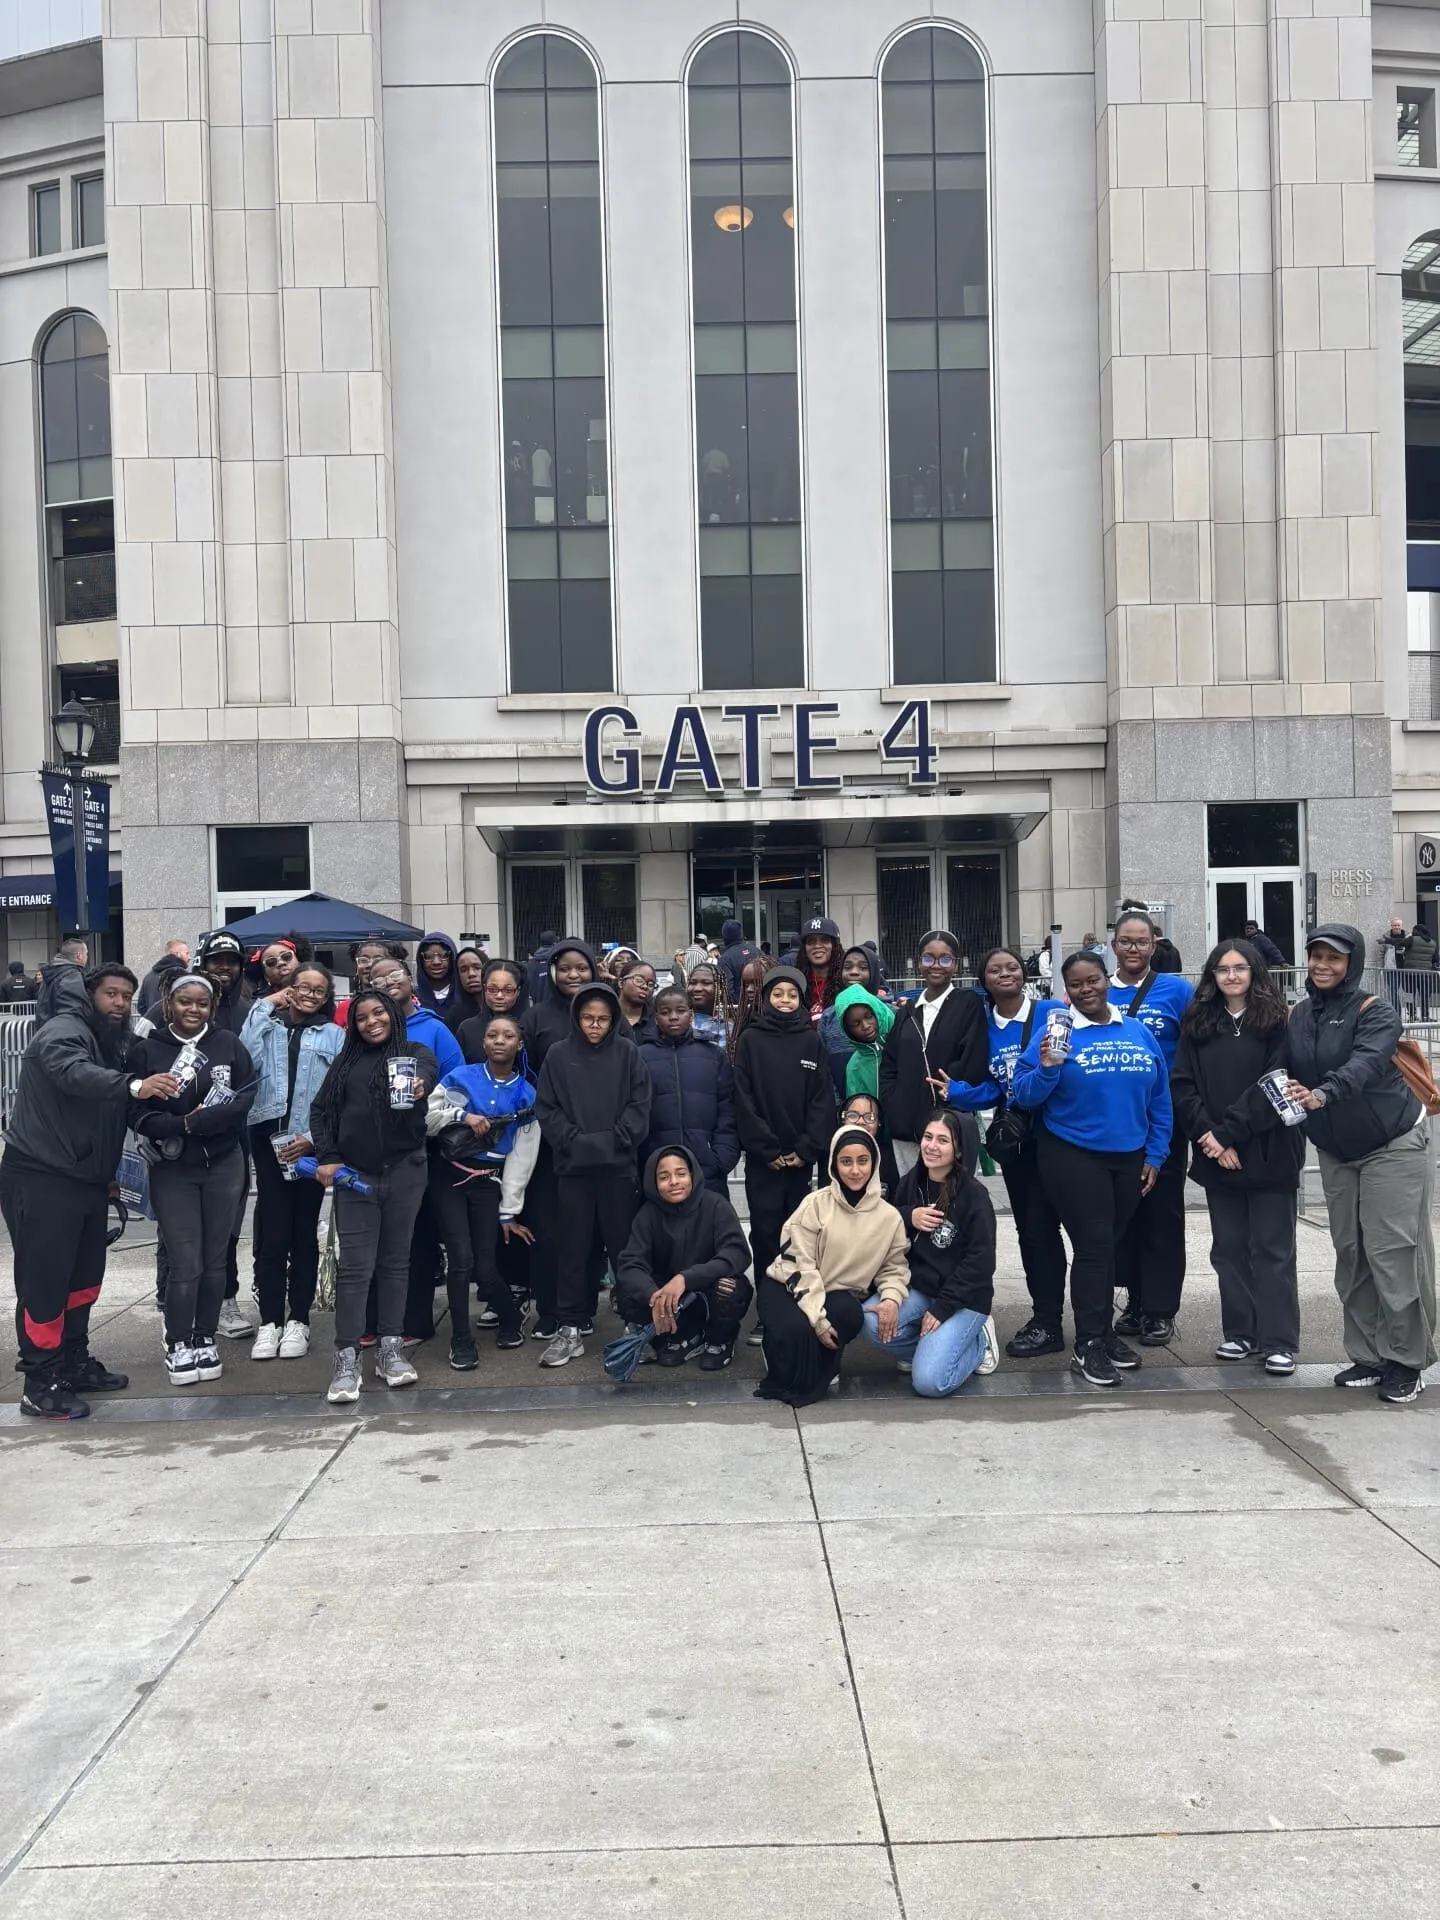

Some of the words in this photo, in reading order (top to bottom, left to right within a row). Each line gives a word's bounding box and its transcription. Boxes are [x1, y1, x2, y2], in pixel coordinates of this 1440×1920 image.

[583, 702, 843, 795] GATE
[880, 700, 939, 786] 4
[51, 794, 67, 808] GATE
[68, 797, 73, 808] 2
[84, 800, 100, 813] GATE
[101, 803, 105, 814] 4
[1331, 869, 1373, 883] PRESS
[1331, 883, 1373, 898] GATE
[8, 894, 52, 906] ENTRANCE
